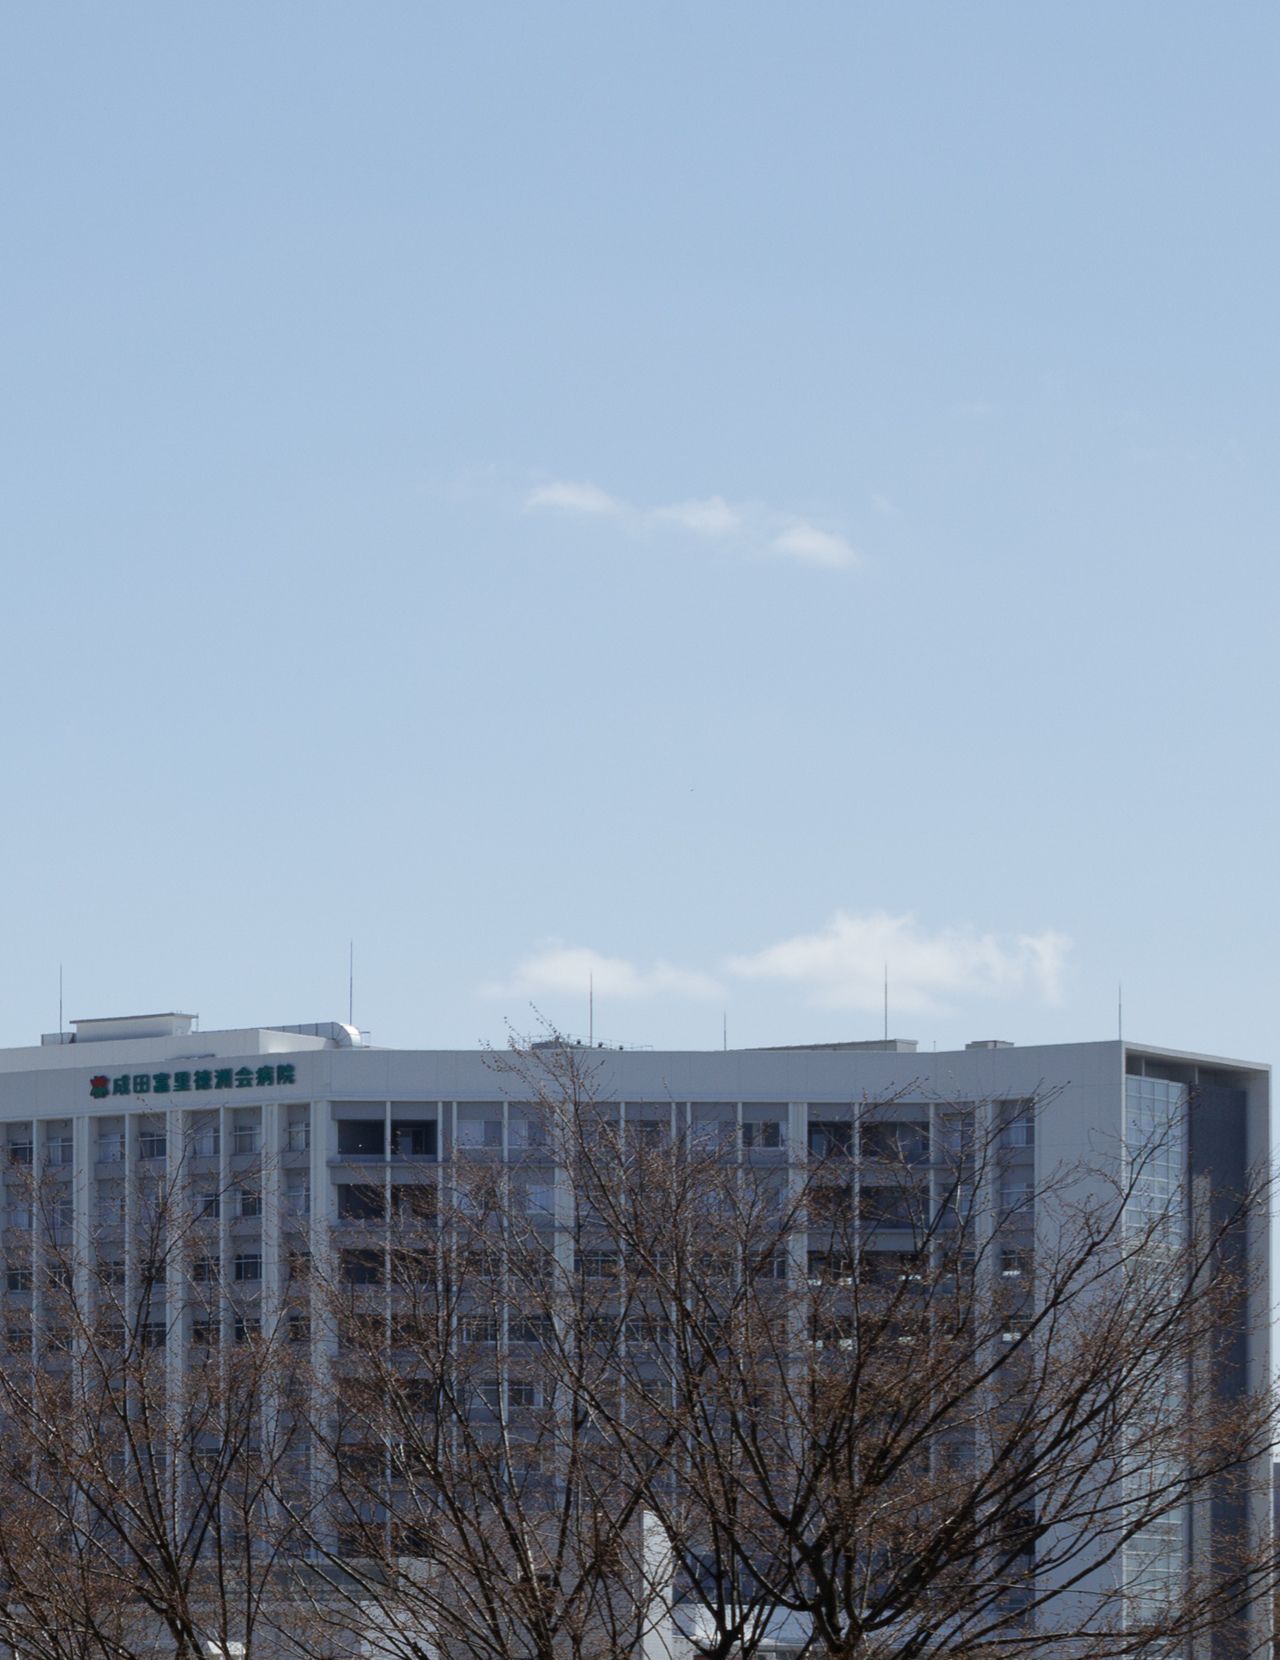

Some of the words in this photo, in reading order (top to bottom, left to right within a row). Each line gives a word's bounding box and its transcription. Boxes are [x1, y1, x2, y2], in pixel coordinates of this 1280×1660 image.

[112, 1063, 296, 1096] 成田富里徳洲会病院
